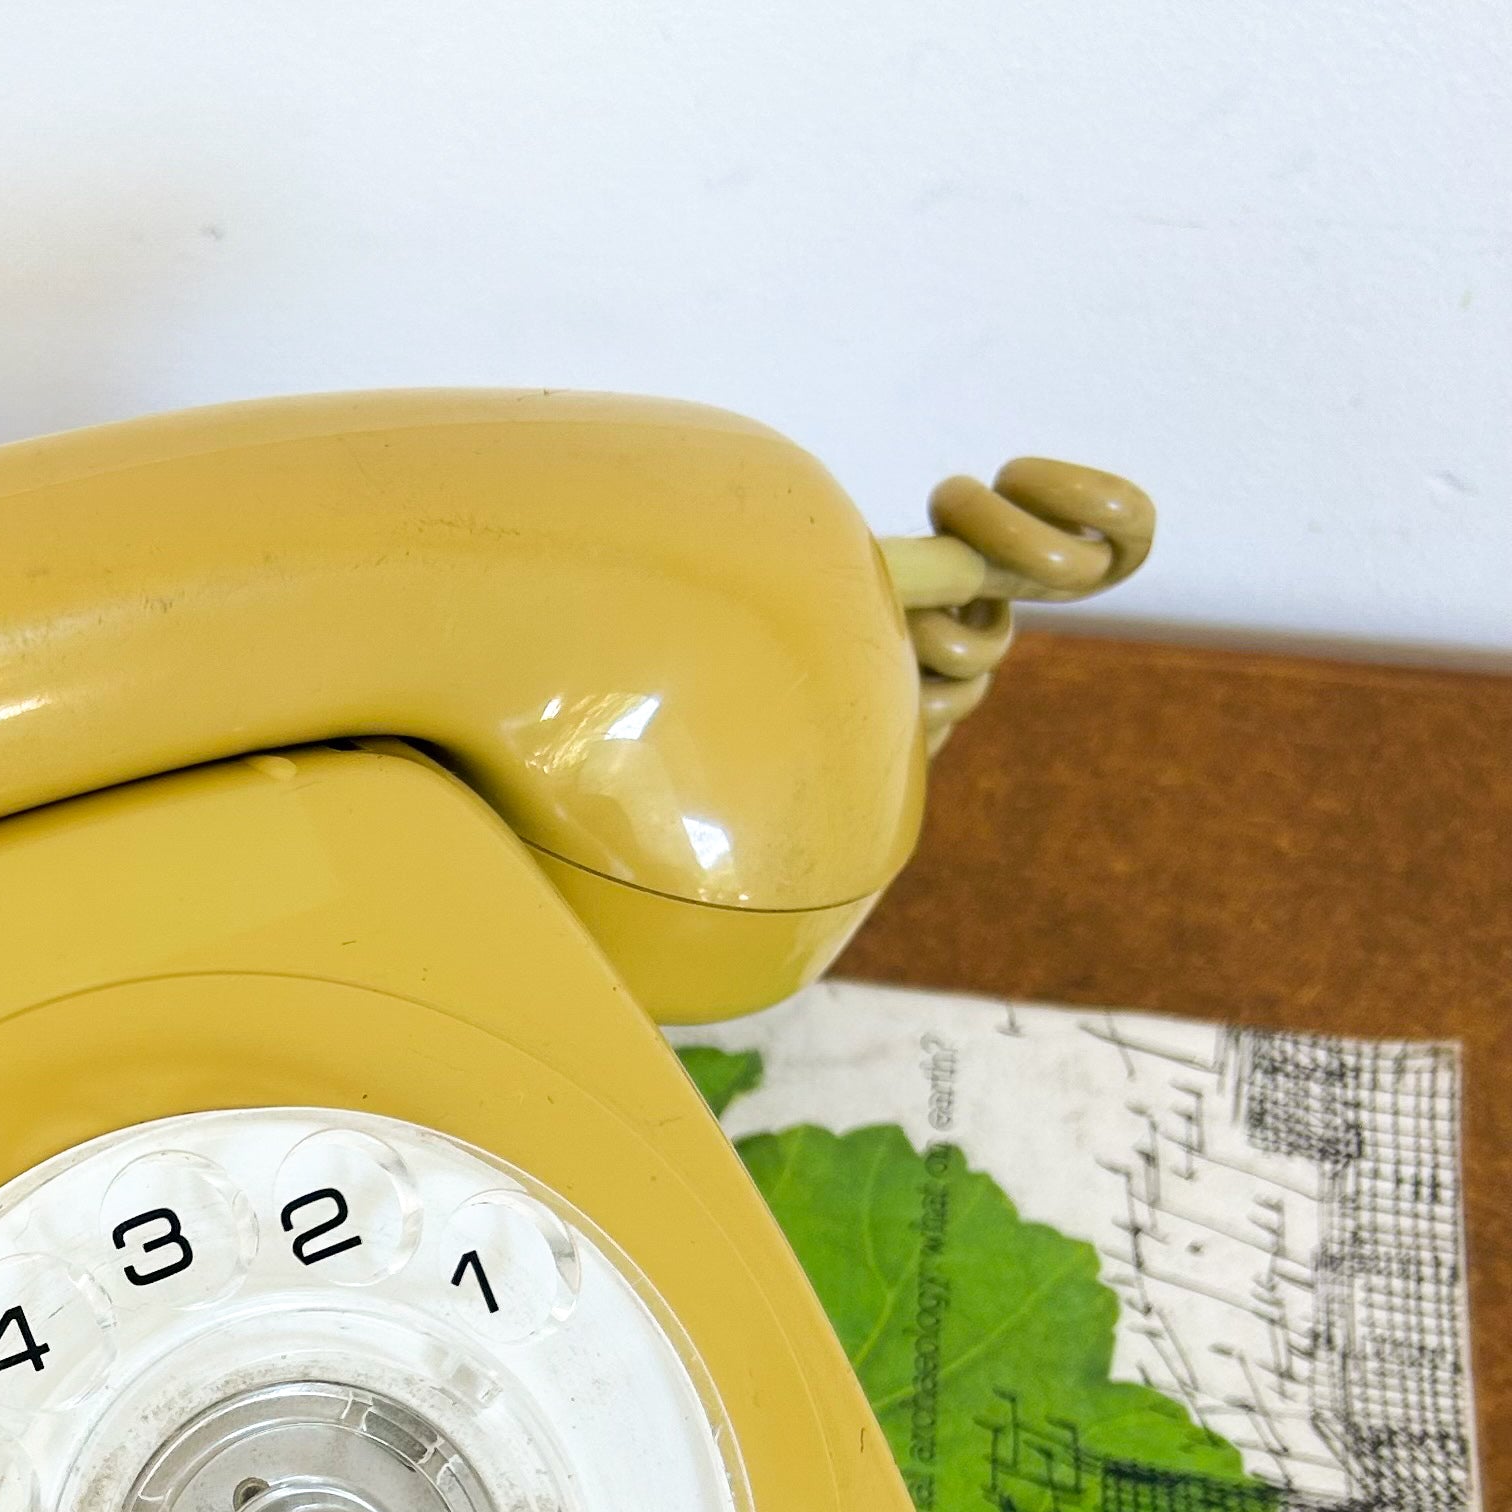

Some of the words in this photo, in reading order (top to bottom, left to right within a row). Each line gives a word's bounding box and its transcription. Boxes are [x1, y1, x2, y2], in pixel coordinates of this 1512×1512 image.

[111, 1207, 194, 1287] 3
[279, 1187, 363, 1266] 2
[450, 1250, 500, 1314] 1
